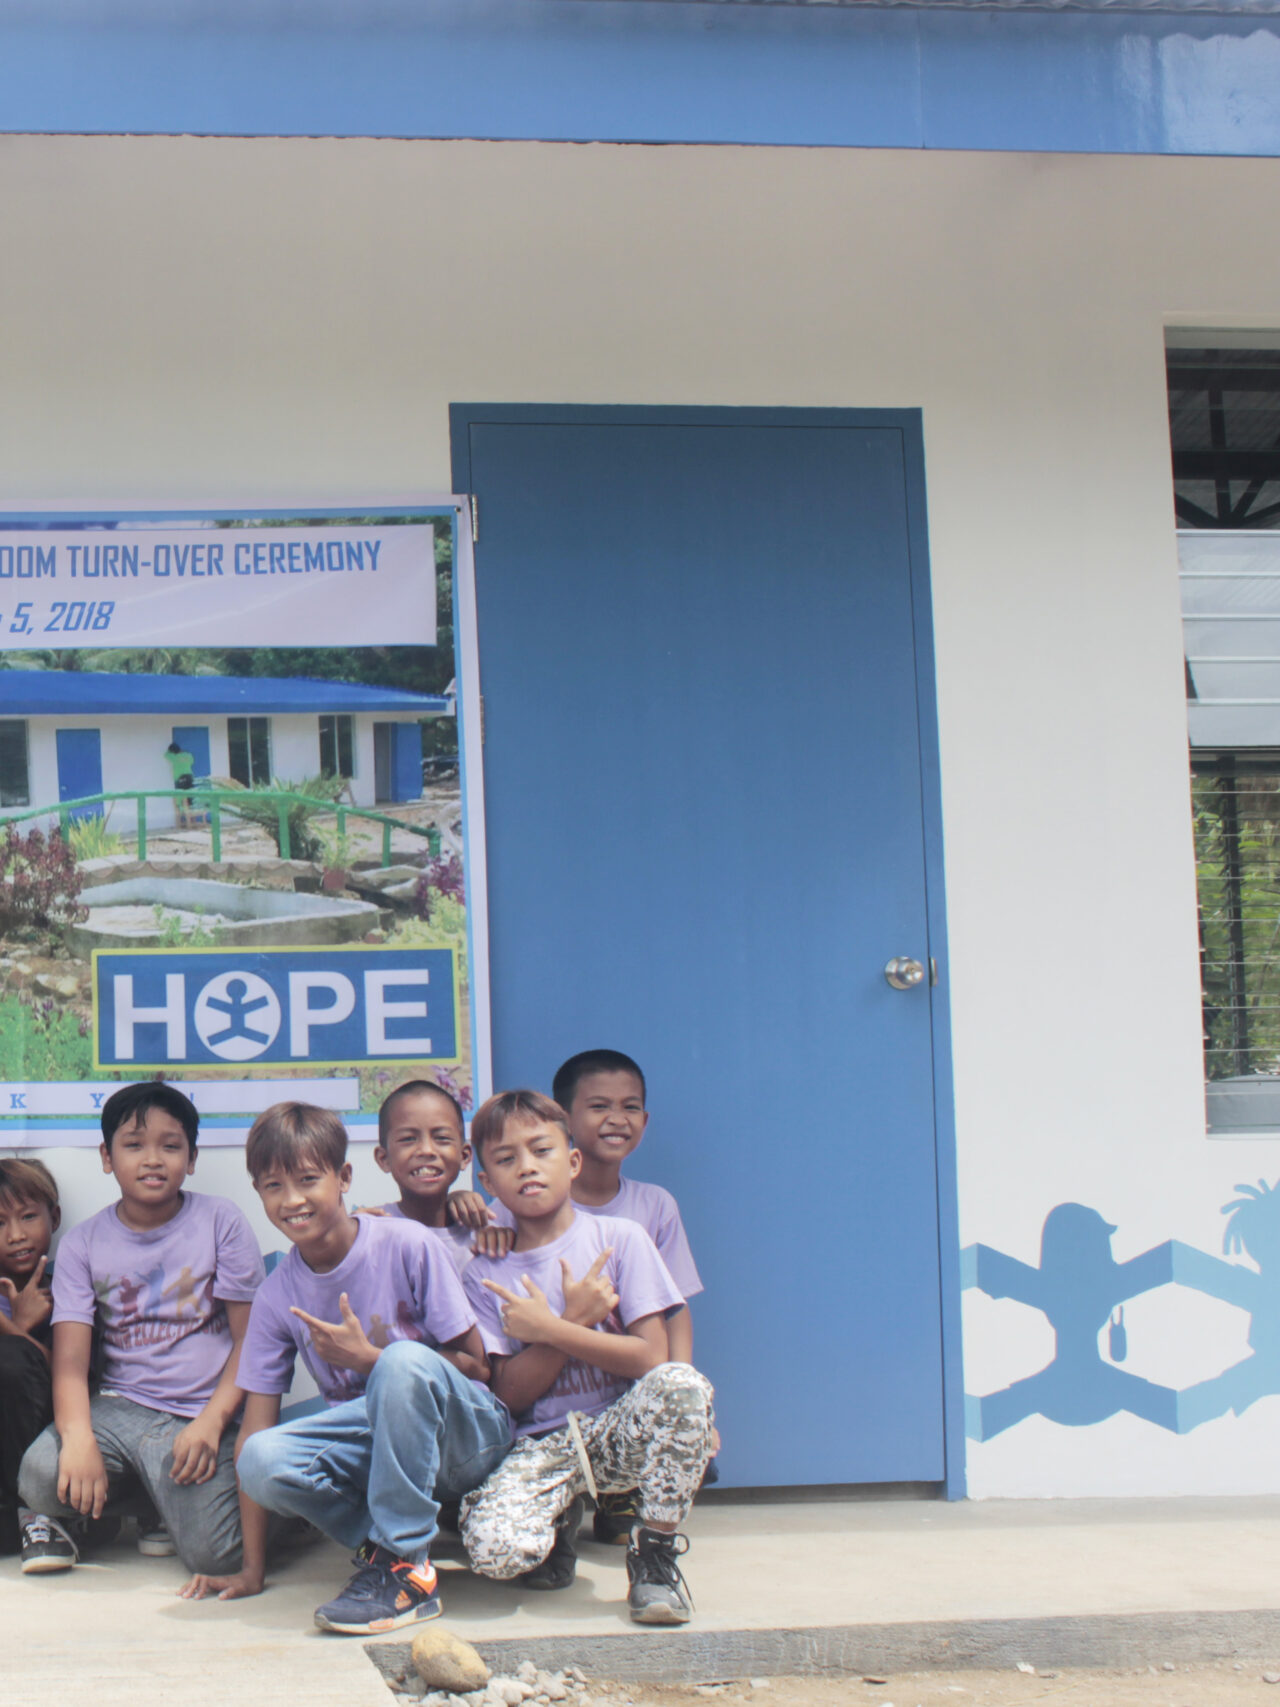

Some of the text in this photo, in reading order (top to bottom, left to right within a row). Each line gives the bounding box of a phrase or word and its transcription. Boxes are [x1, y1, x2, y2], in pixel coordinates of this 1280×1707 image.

[66, 544, 224, 578] TURN-OVER
[234, 540, 382, 576] CEREMONY
[8, 602, 34, 636] 5,
[43, 601, 116, 632] 2018
[113, 968, 433, 1062] HOPE
